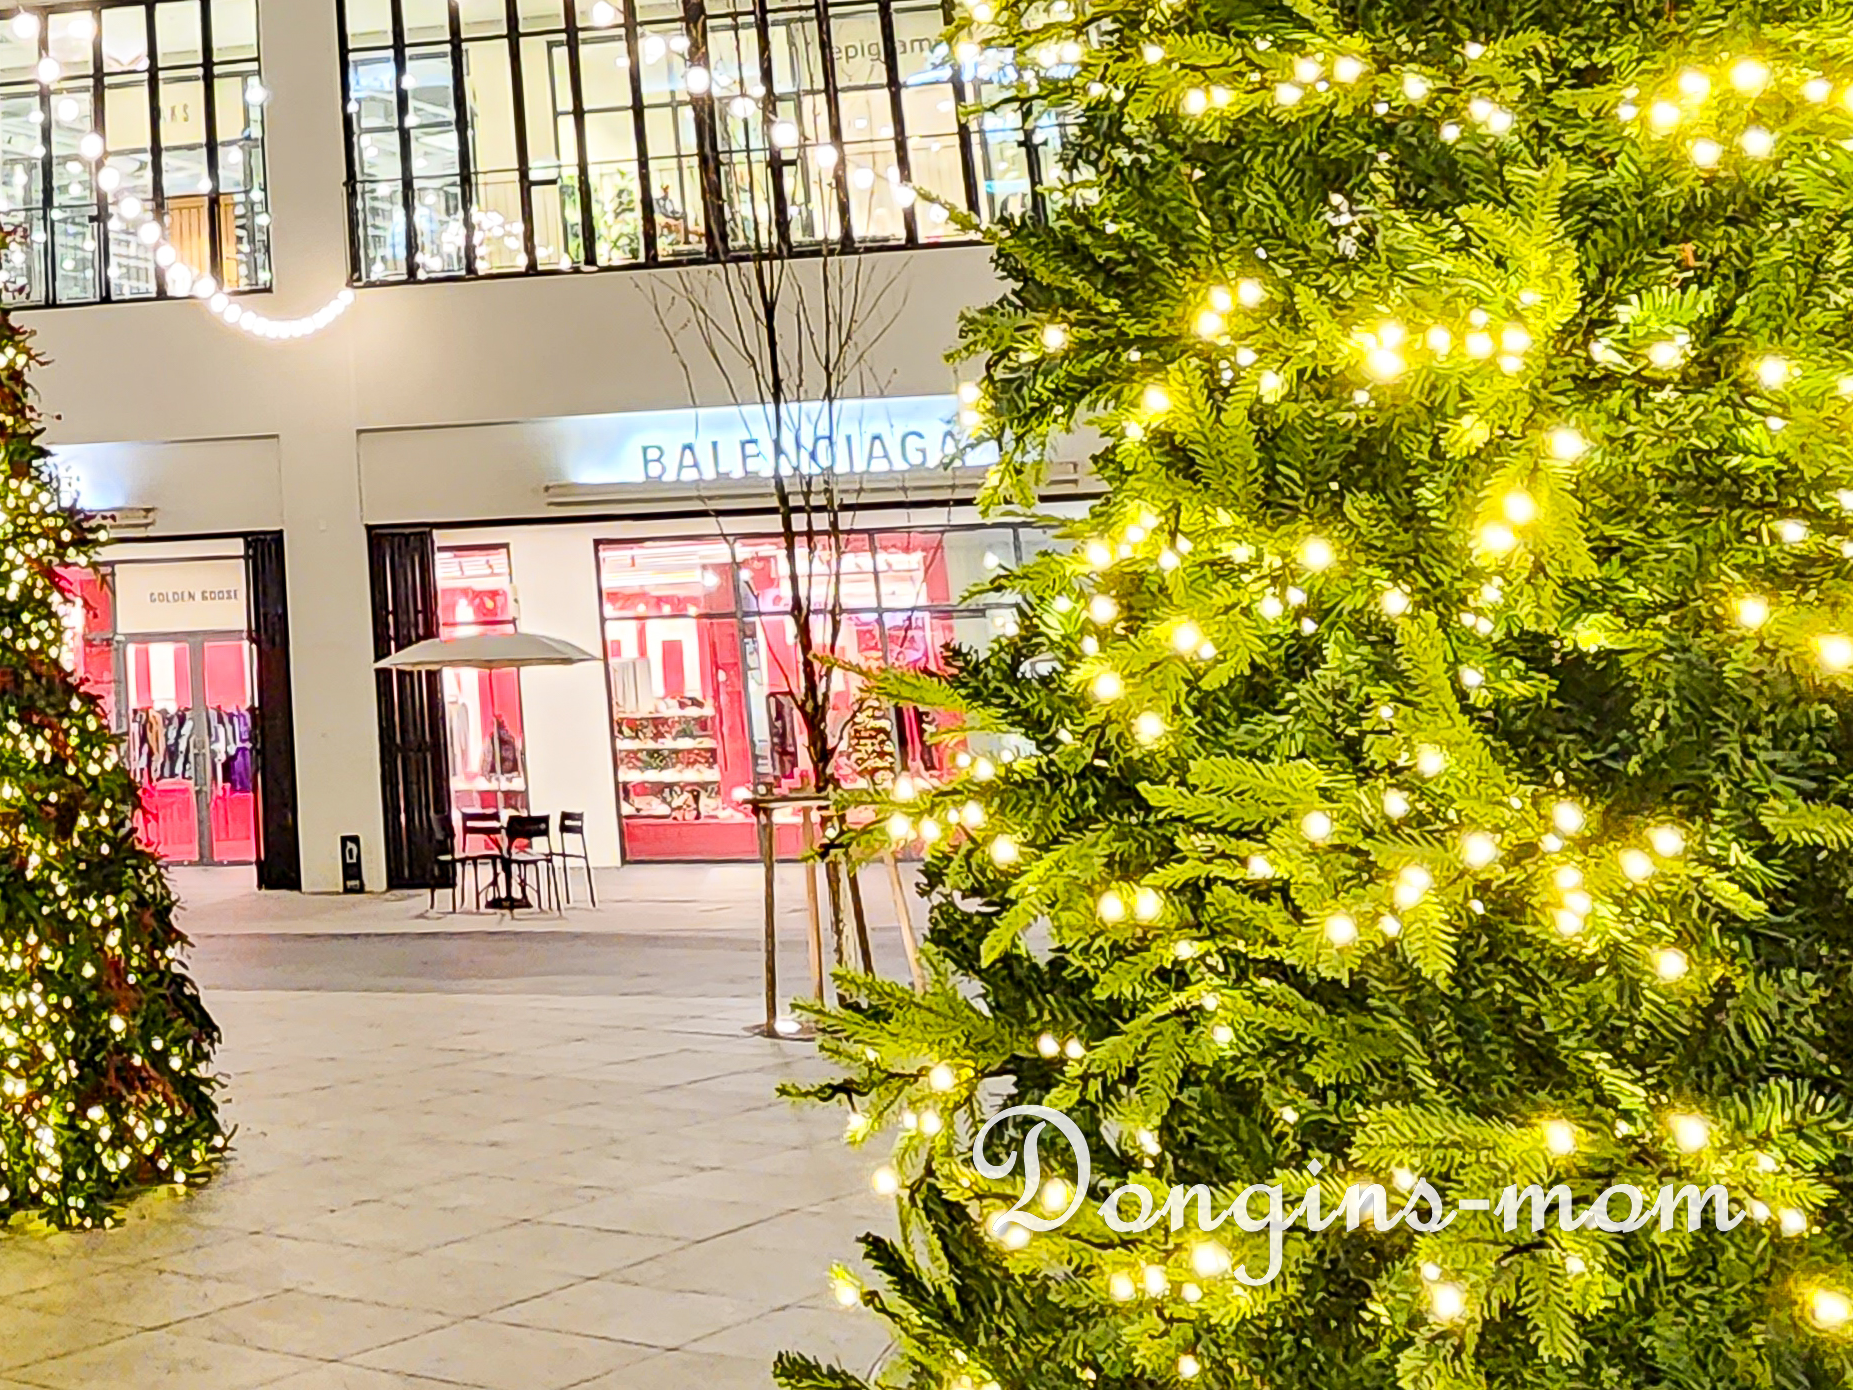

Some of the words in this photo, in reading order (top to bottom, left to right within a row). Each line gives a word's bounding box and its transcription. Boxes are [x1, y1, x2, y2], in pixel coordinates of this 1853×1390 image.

[832, 37, 932, 64] epigam
[641, 429, 966, 481] BALENCIAGA
[149, 591, 196, 603] GOLDEN
[201, 589, 238, 601] GOOSE
